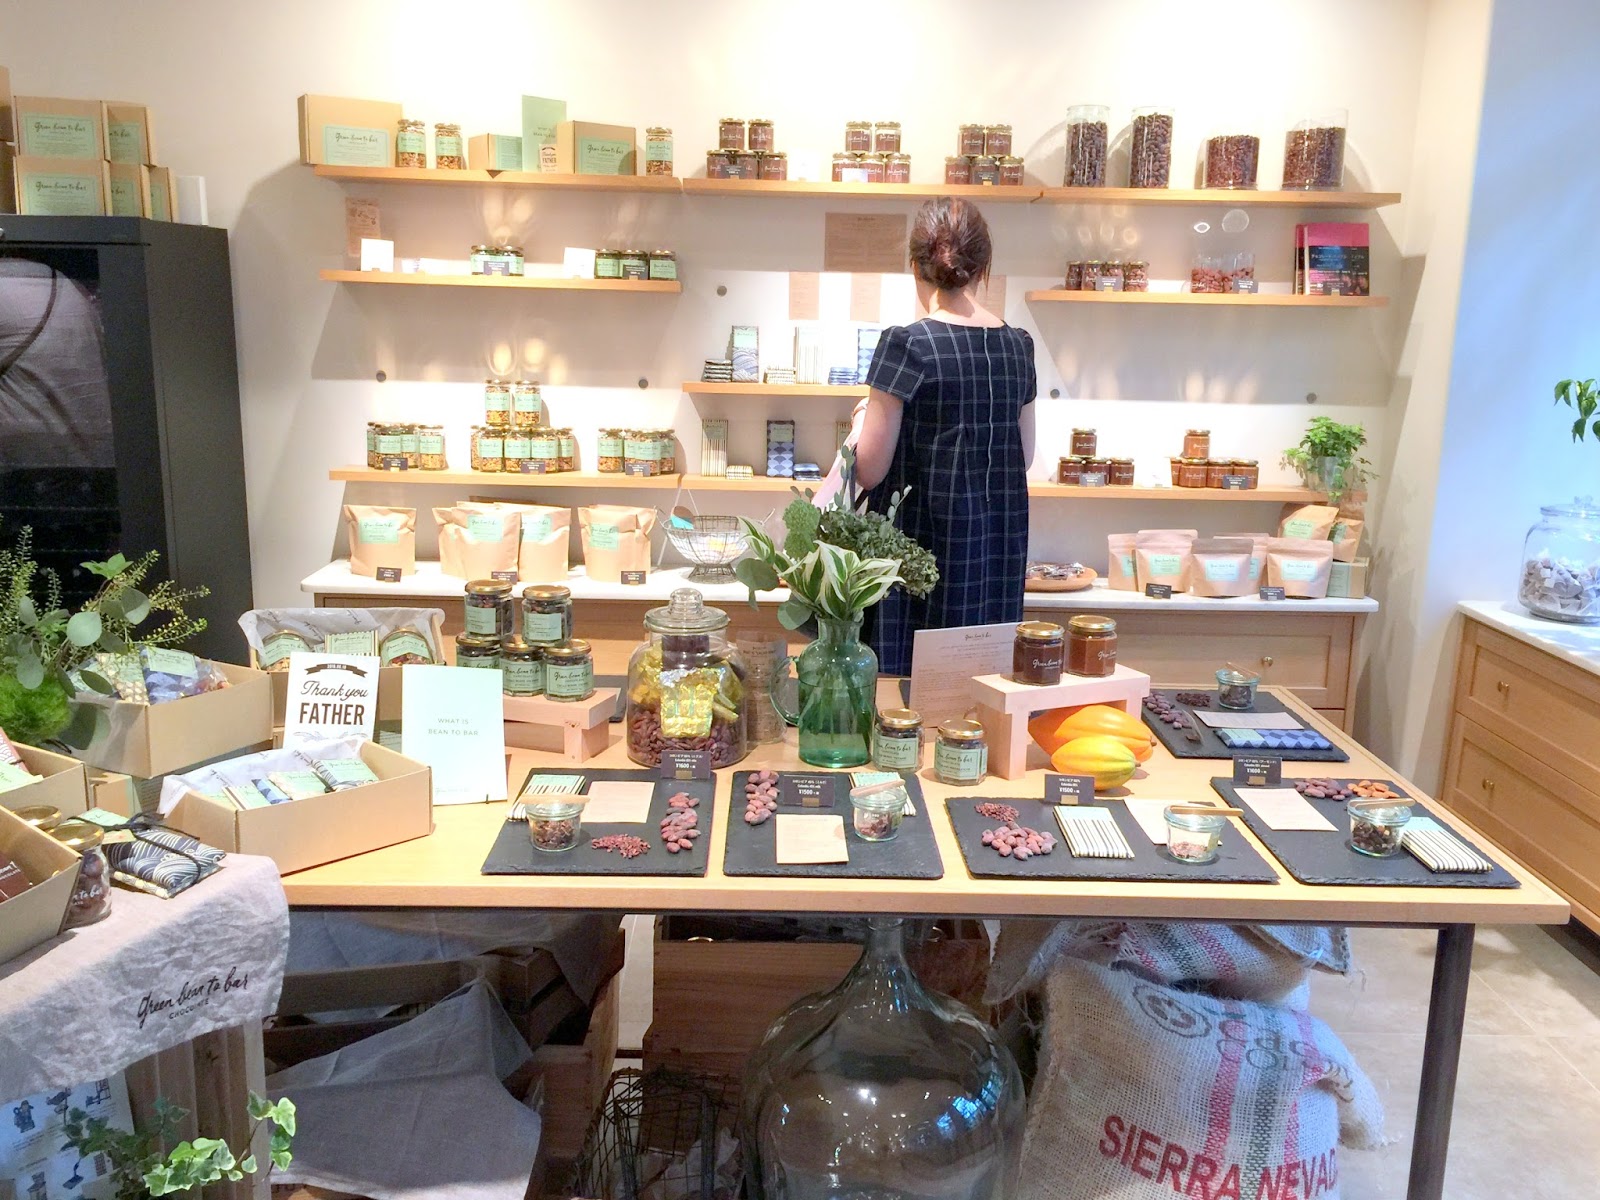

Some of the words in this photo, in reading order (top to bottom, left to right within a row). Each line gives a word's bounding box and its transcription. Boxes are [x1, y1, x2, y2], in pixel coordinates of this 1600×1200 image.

[301, 680, 344, 697] Thank
[340, 688, 368, 701] you
[299, 702, 365, 725] FATHER
[208, 976, 220, 994] to
[224, 966, 248, 992] bar
[1100, 1114, 1240, 1200] SIERRA
